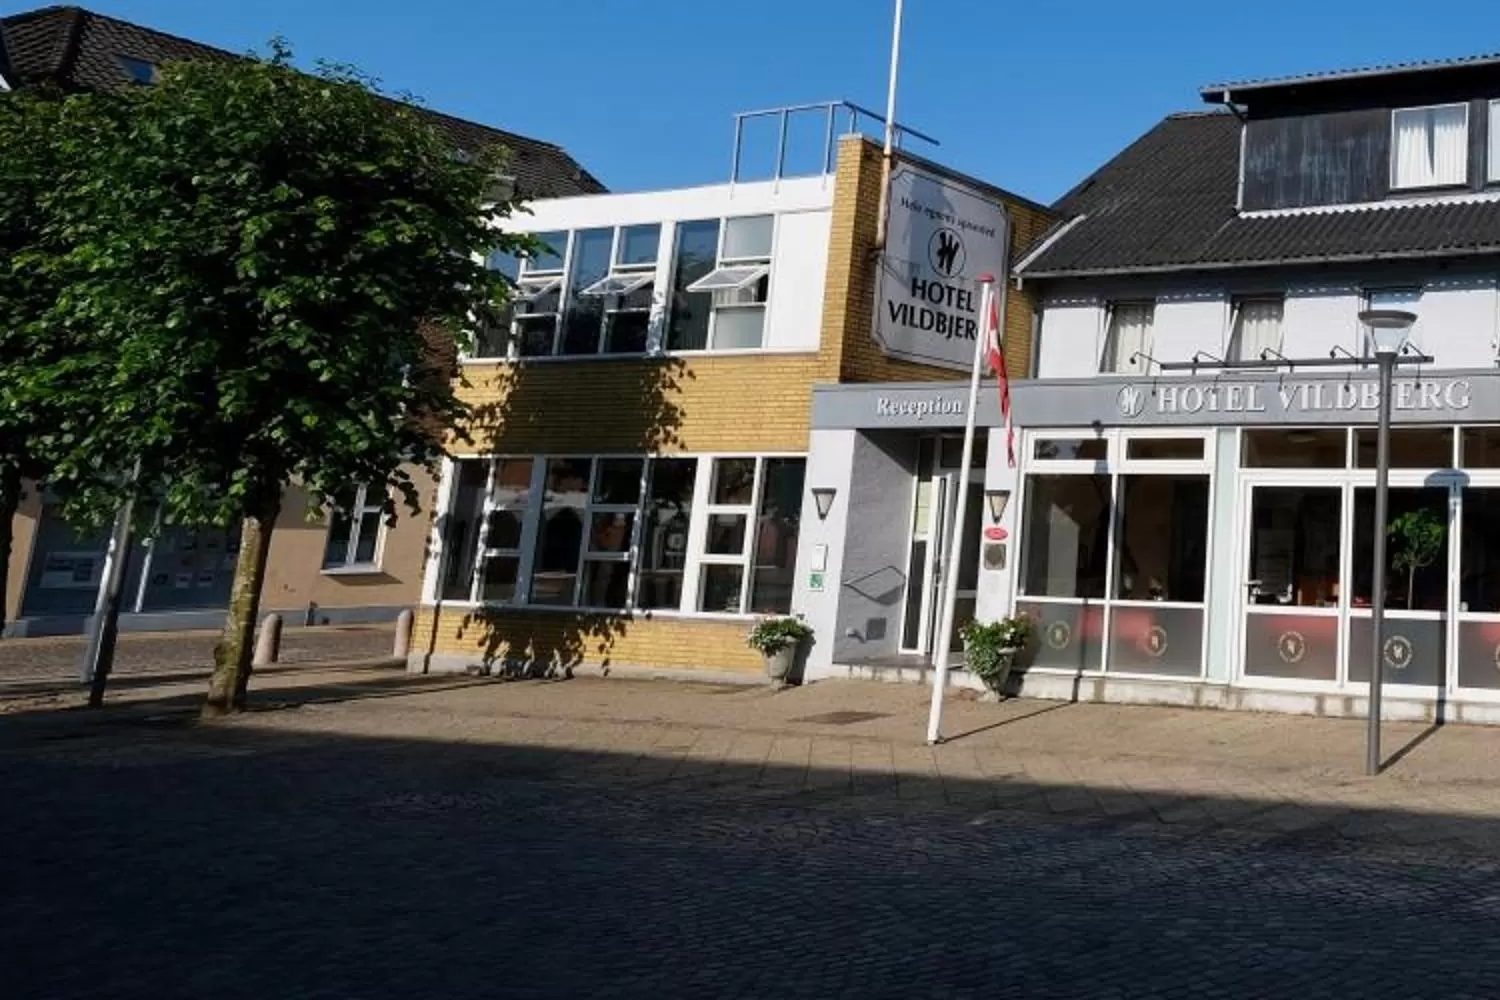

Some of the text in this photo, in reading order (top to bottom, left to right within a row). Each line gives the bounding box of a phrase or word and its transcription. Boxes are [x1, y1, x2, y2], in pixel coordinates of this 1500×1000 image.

[911, 277, 975, 313] HOTEL
[888, 300, 980, 341] VILDBJER
[876, 395, 965, 421] Reception
[1157, 384, 1266, 414] HOTEL
[1279, 380, 1472, 413] VILDBERG
